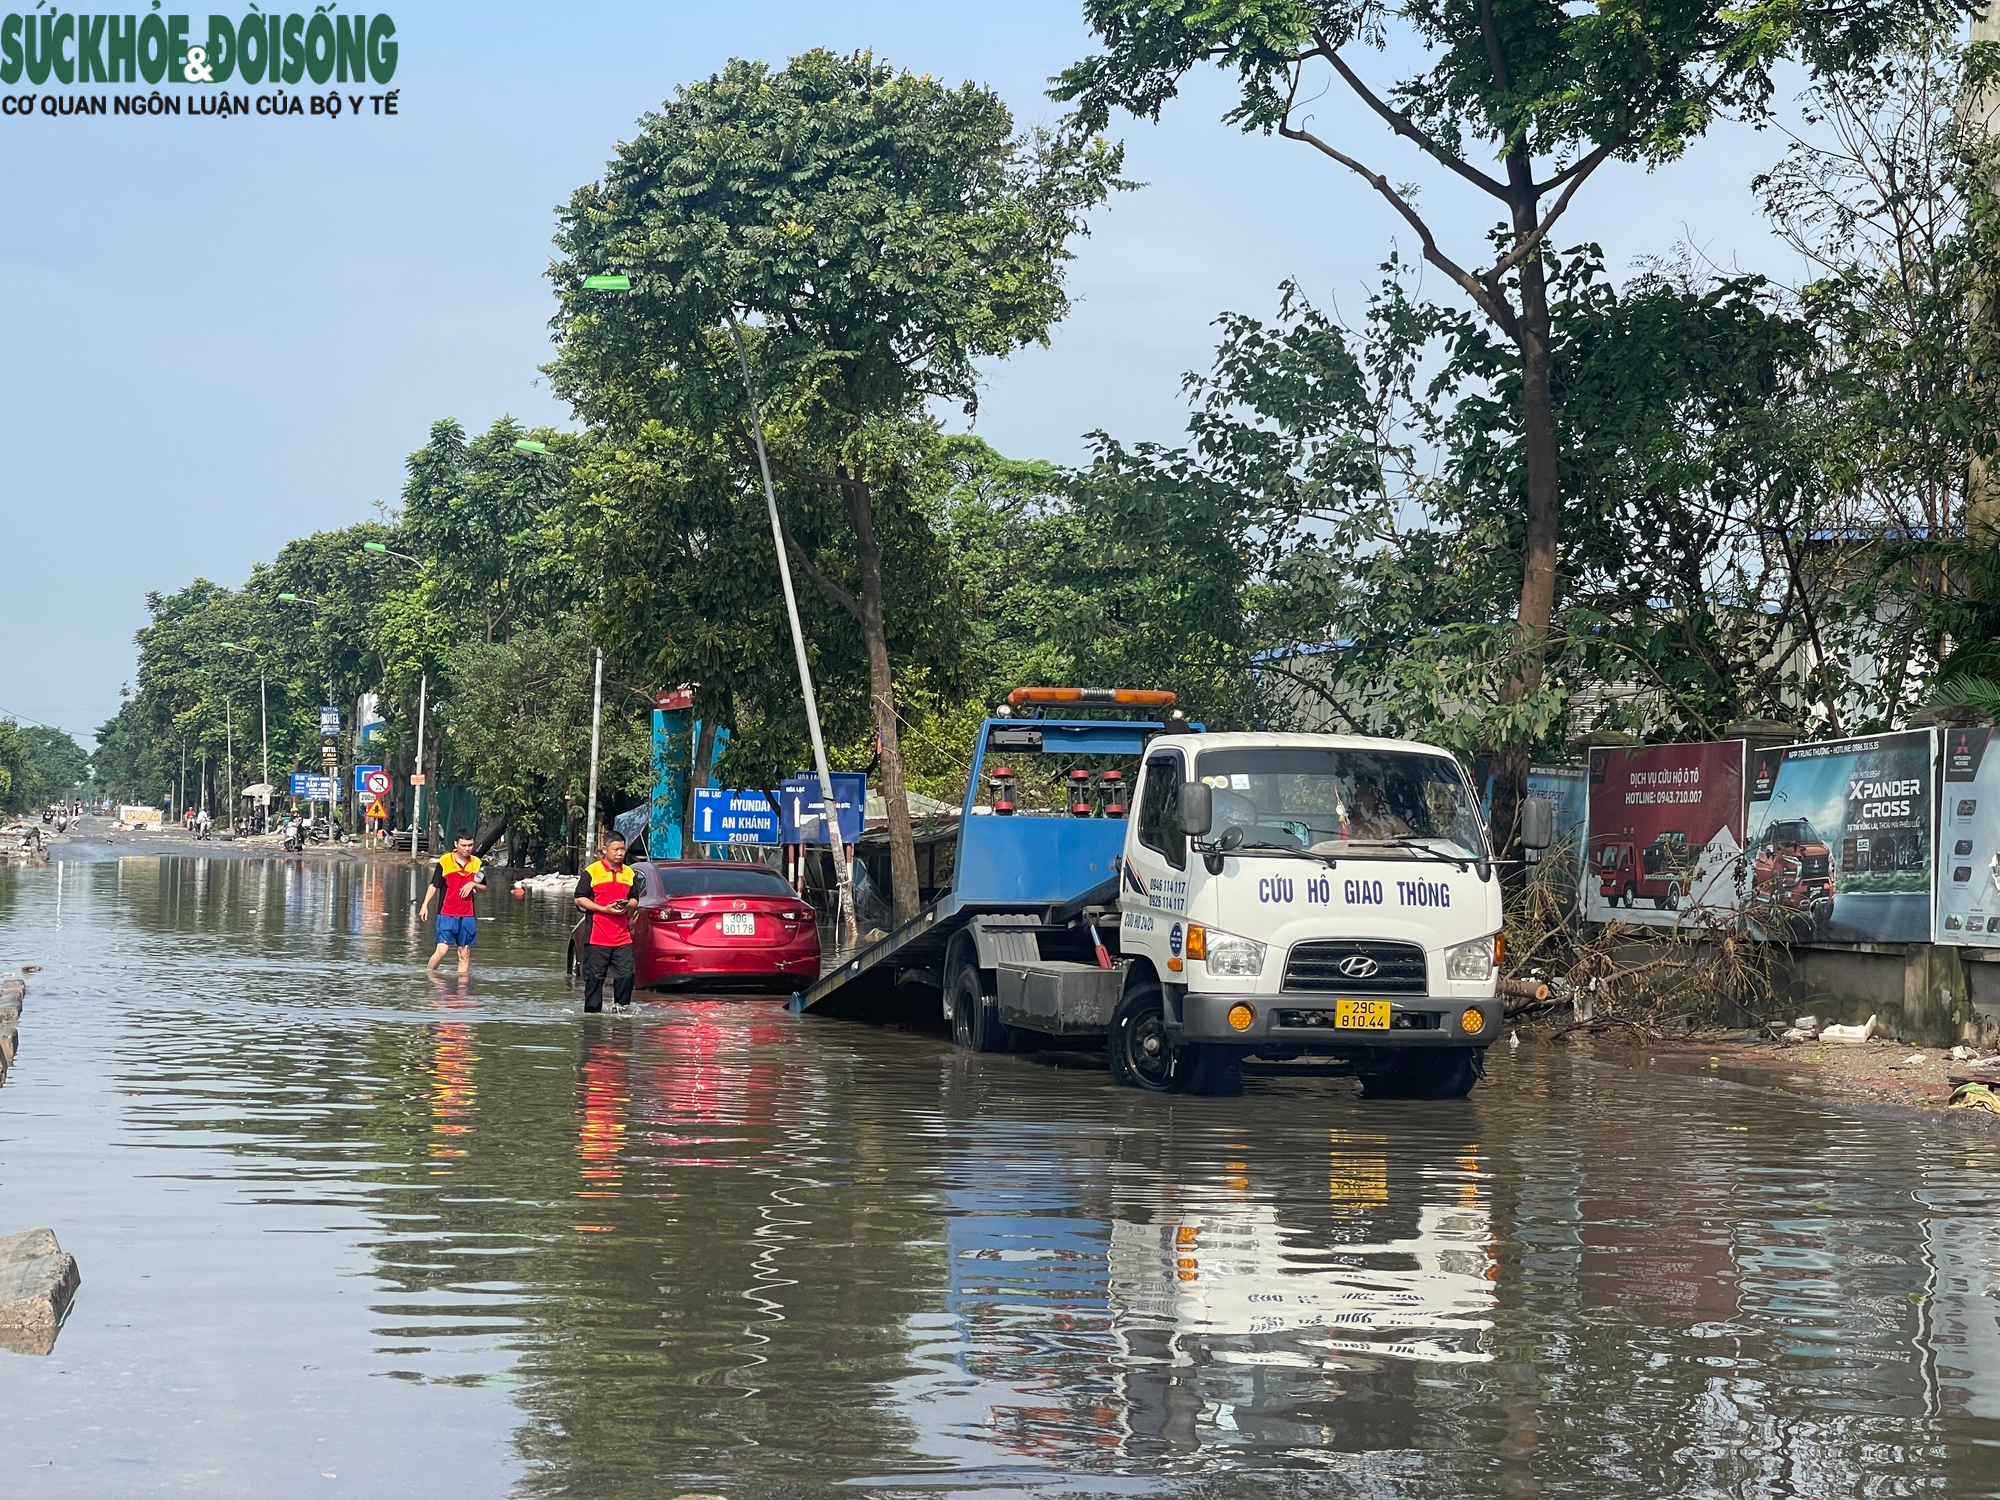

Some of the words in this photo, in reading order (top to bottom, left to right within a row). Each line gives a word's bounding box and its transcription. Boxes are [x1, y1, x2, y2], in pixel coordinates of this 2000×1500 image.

[321, 713, 340, 724] HOTEL
[1630, 772, 1646, 788] DỊCH
[1647, 772, 1657, 788] VỤ
[1672, 767, 1682, 787] HỘ
[1683, 767, 1689, 783] Ô
[1689, 767, 1699, 783] TÔ
[711, 791, 722, 799] LẠC
[1849, 779, 1920, 800] XPANDER
[1625, 792, 1656, 805] HOTLINE:
[1657, 790, 1703, 804] 0943.710.007
[730, 799, 771, 812] HYUNDAI
[1863, 800, 1910, 818] CROSS
[722, 817, 736, 829] AN
[738, 815, 771, 830] KHÁNH
[729, 833, 759, 842] 200M
[1163, 880, 1174, 893] 114
[1175, 881, 1186, 894] 117
[1259, 873, 1294, 903] CỨU
[1307, 874, 1331, 907] HỘ
[1344, 879, 1384, 905] GIAO
[1396, 876, 1451, 908] THÔNG
[1162, 896, 1173, 909] 114
[1173, 898, 1185, 911] 117
[730, 913, 747, 924] 30G
[1141, 916, 1155, 931] 24/24
[1352, 1001, 1376, 1014] 29C
[1341, 1014, 1385, 1028] 810.44
